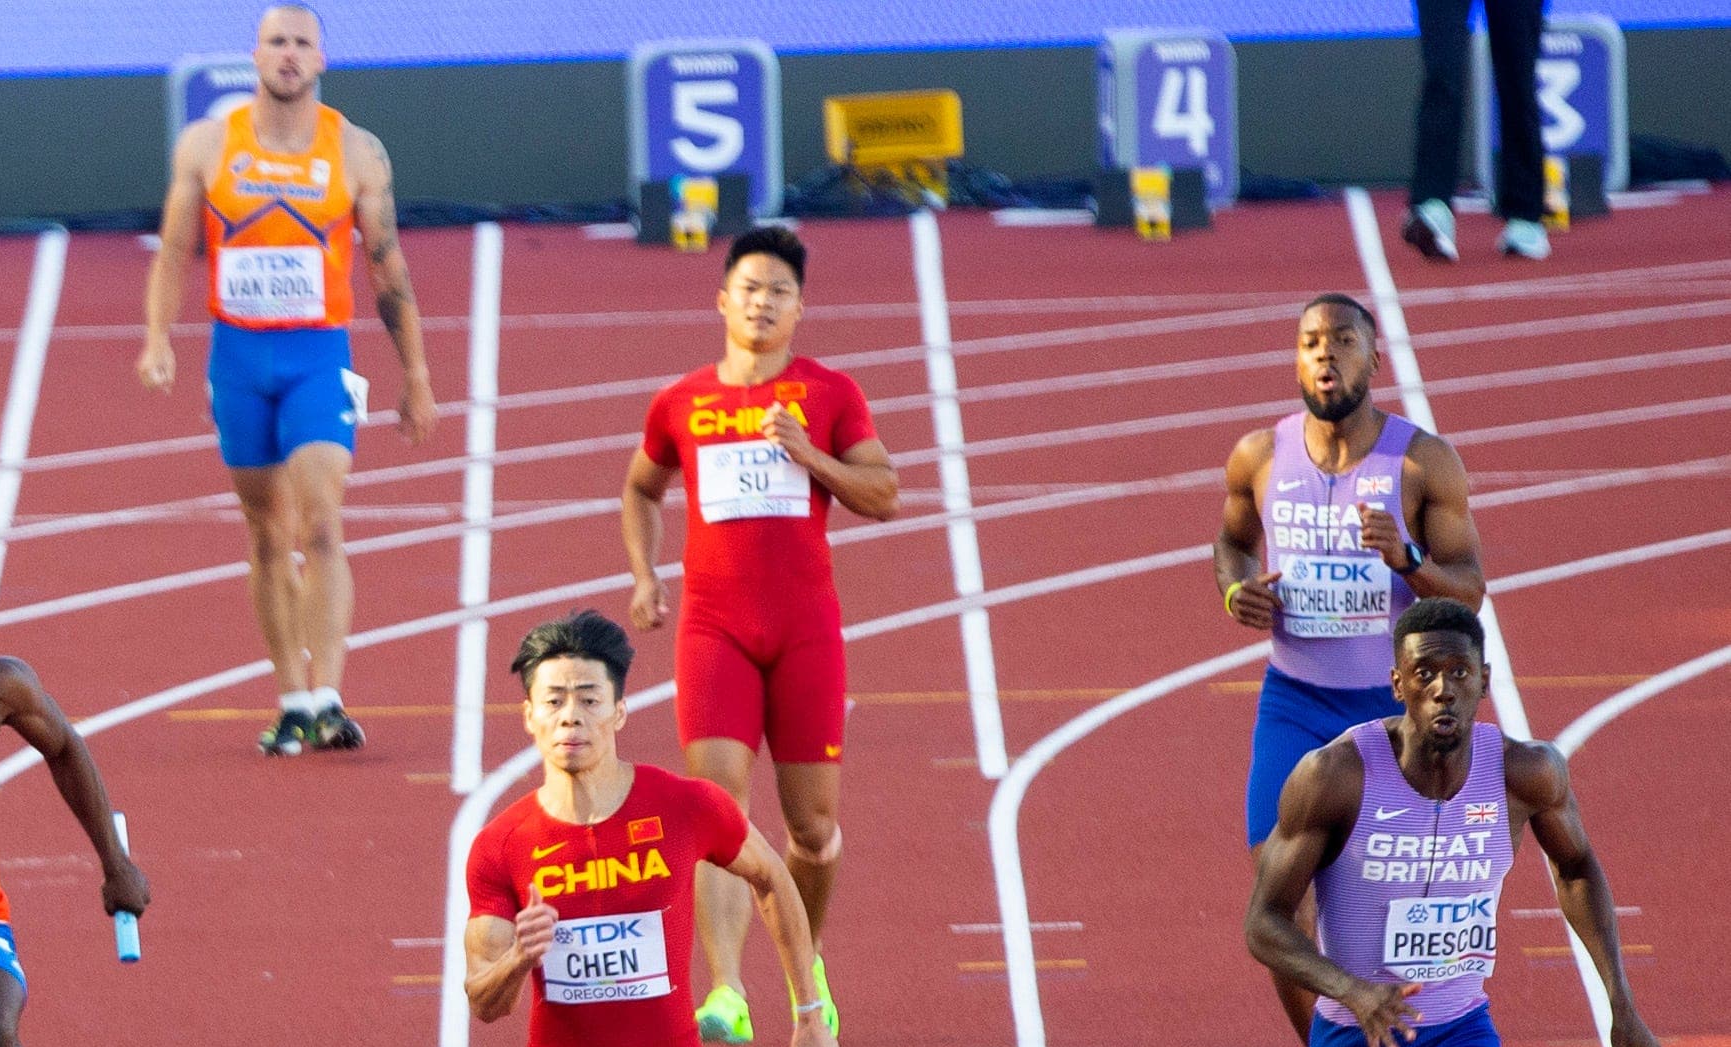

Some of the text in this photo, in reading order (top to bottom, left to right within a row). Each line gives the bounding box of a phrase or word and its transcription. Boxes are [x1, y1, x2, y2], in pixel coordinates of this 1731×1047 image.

[1153, 66, 1215, 157] 4
[1534, 59, 1586, 150] 3
[671, 79, 744, 172] 5
[688, 401, 809, 437] CHIA
[733, 447, 793, 466] TDK
[739, 471, 770, 494] SU
[1271, 500, 1386, 528] GREA
[1274, 526, 1371, 552] BRITAI
[1310, 562, 1373, 583] TDK
[1367, 831, 1492, 859] GREAT
[533, 848, 672, 898] CHINA
[1362, 859, 1492, 882] BRITAIN
[1429, 898, 1493, 923] TDK
[572, 919, 645, 946] TDK
[566, 948, 639, 980] CHEN
[1404, 959, 1486, 981] OREGON22
[562, 983, 649, 1001] OREGON22
